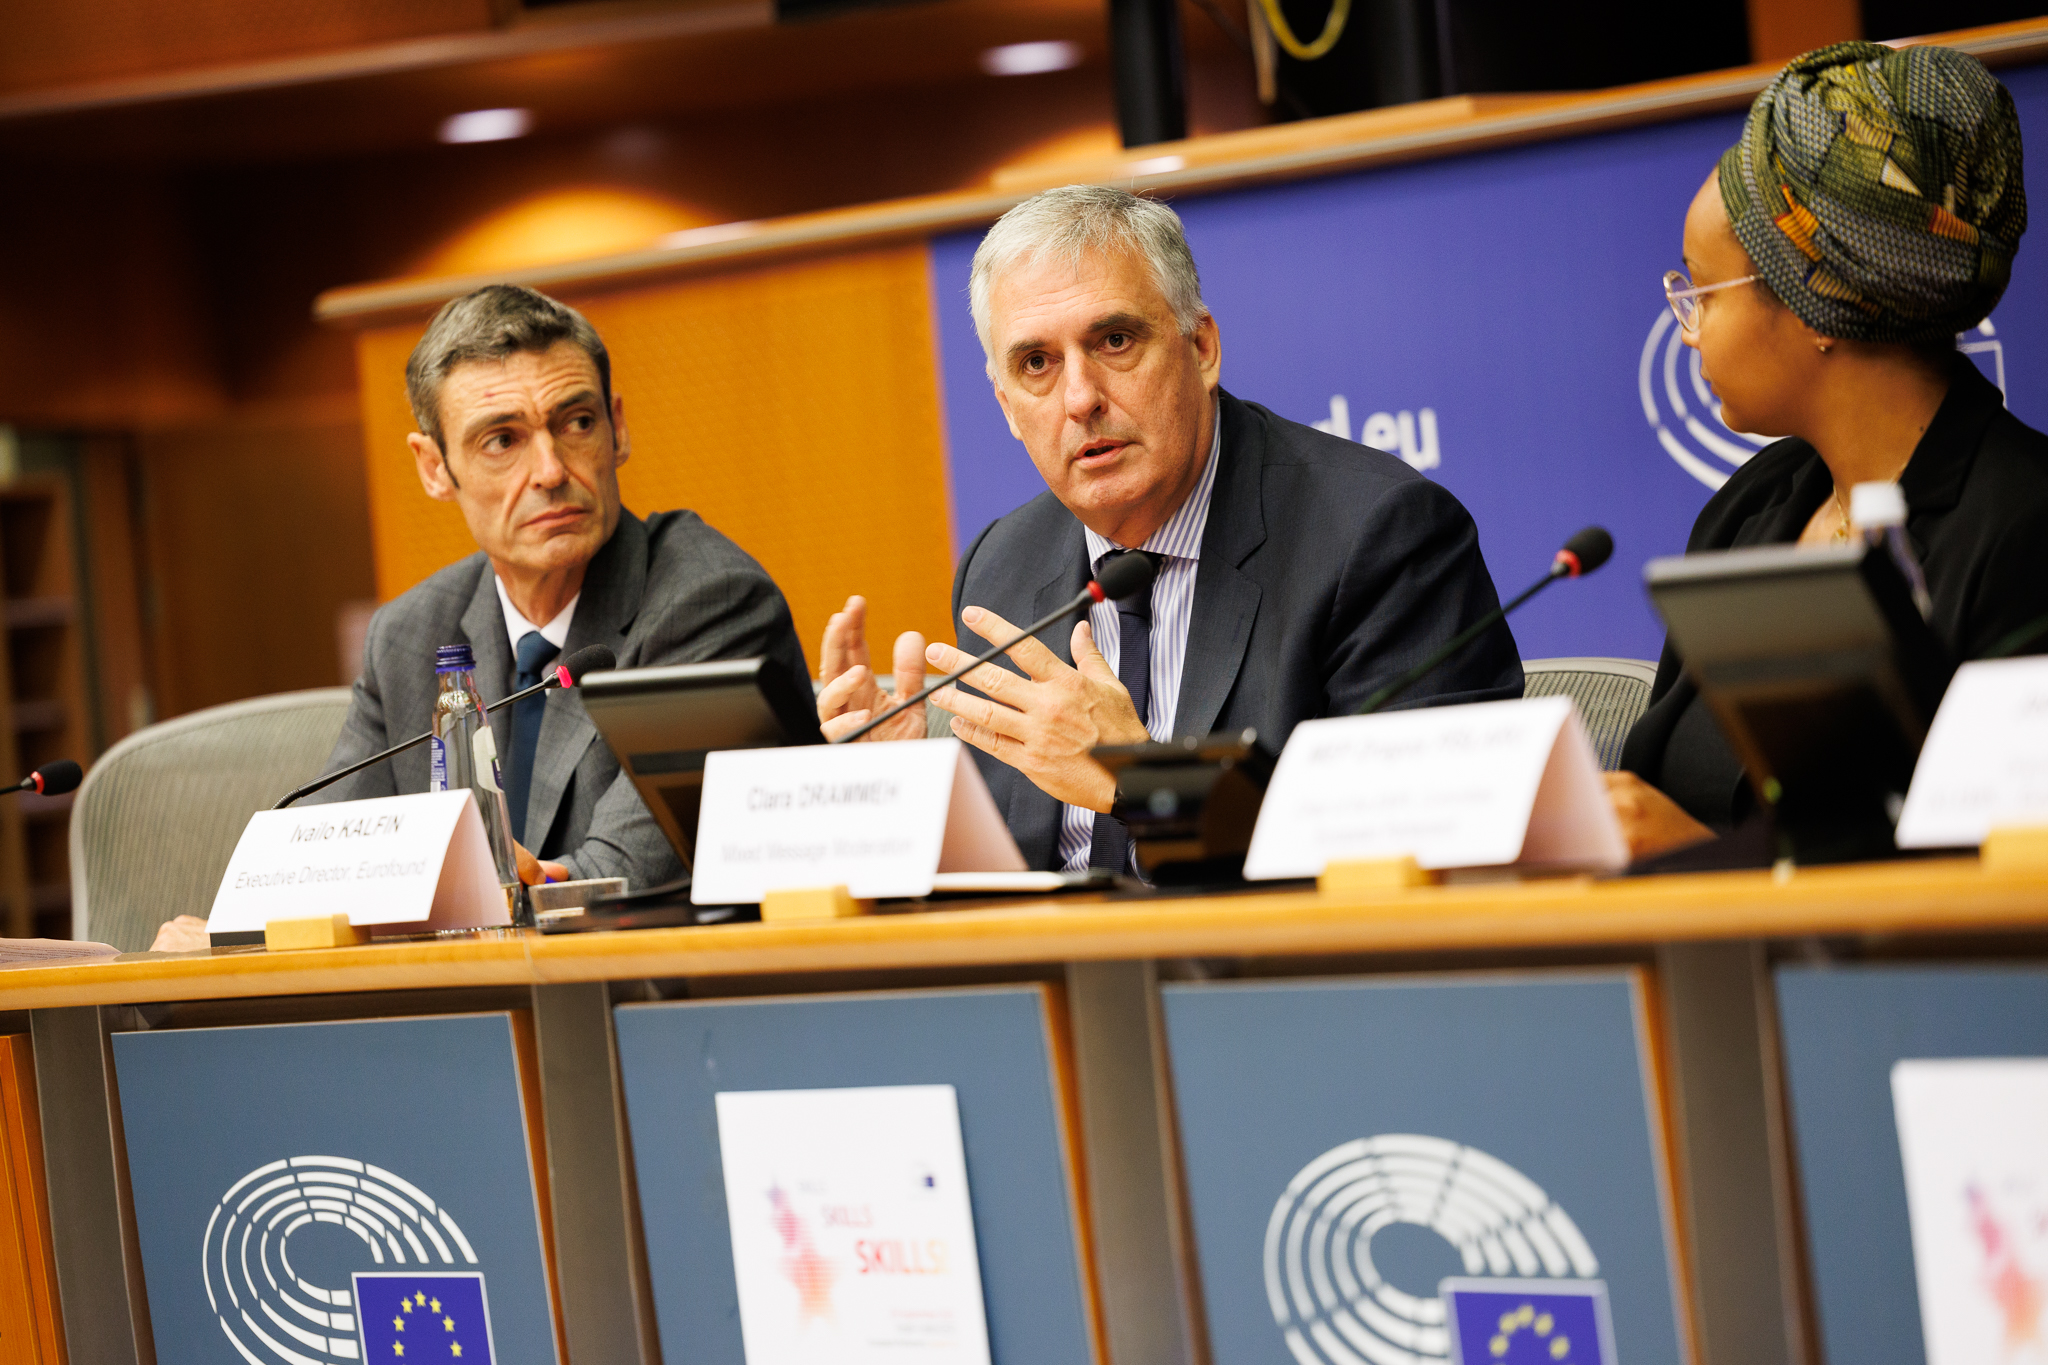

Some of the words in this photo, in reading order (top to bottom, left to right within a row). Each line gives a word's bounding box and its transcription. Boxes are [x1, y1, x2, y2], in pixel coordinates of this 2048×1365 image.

[290, 822, 335, 843] Ivailo
[338, 814, 404, 838] KALFIN
[235, 870, 295, 889] Executive
[357, 858, 427, 879] Eurofound
